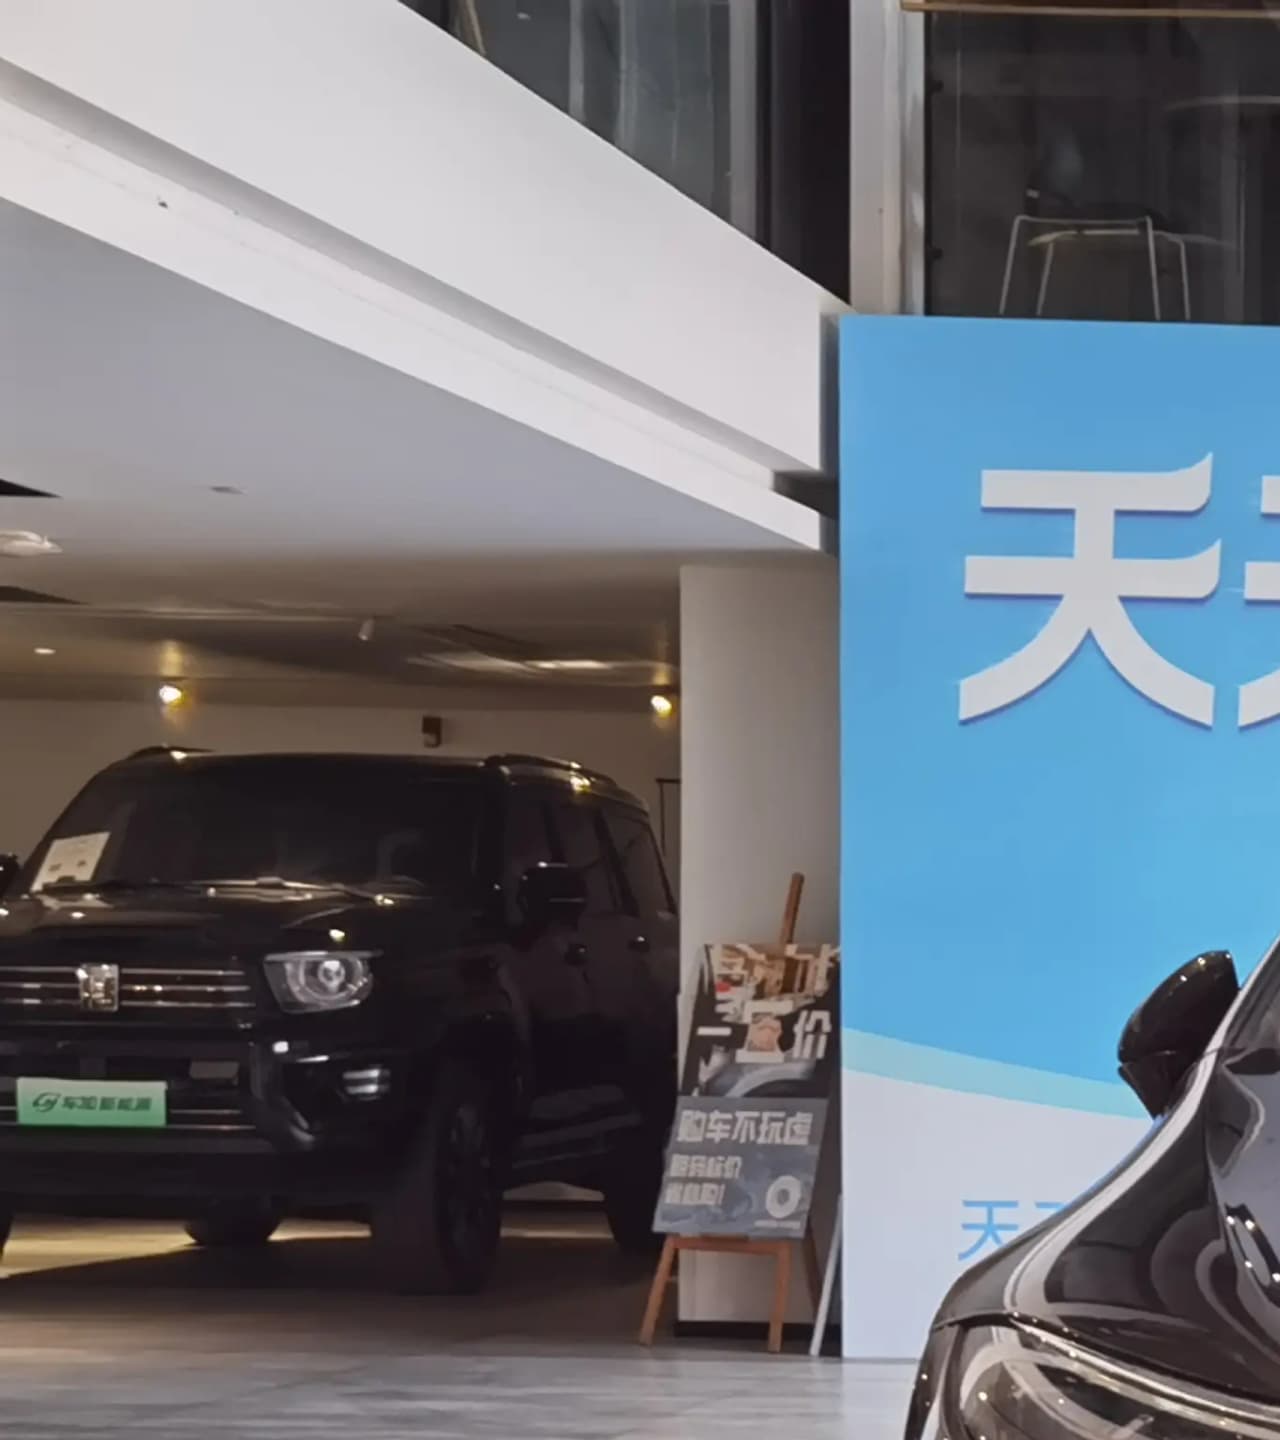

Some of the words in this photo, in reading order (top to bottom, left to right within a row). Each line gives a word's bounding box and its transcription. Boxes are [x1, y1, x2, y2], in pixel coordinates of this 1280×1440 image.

[677, 1110, 813, 1145] 购车不玩虚
